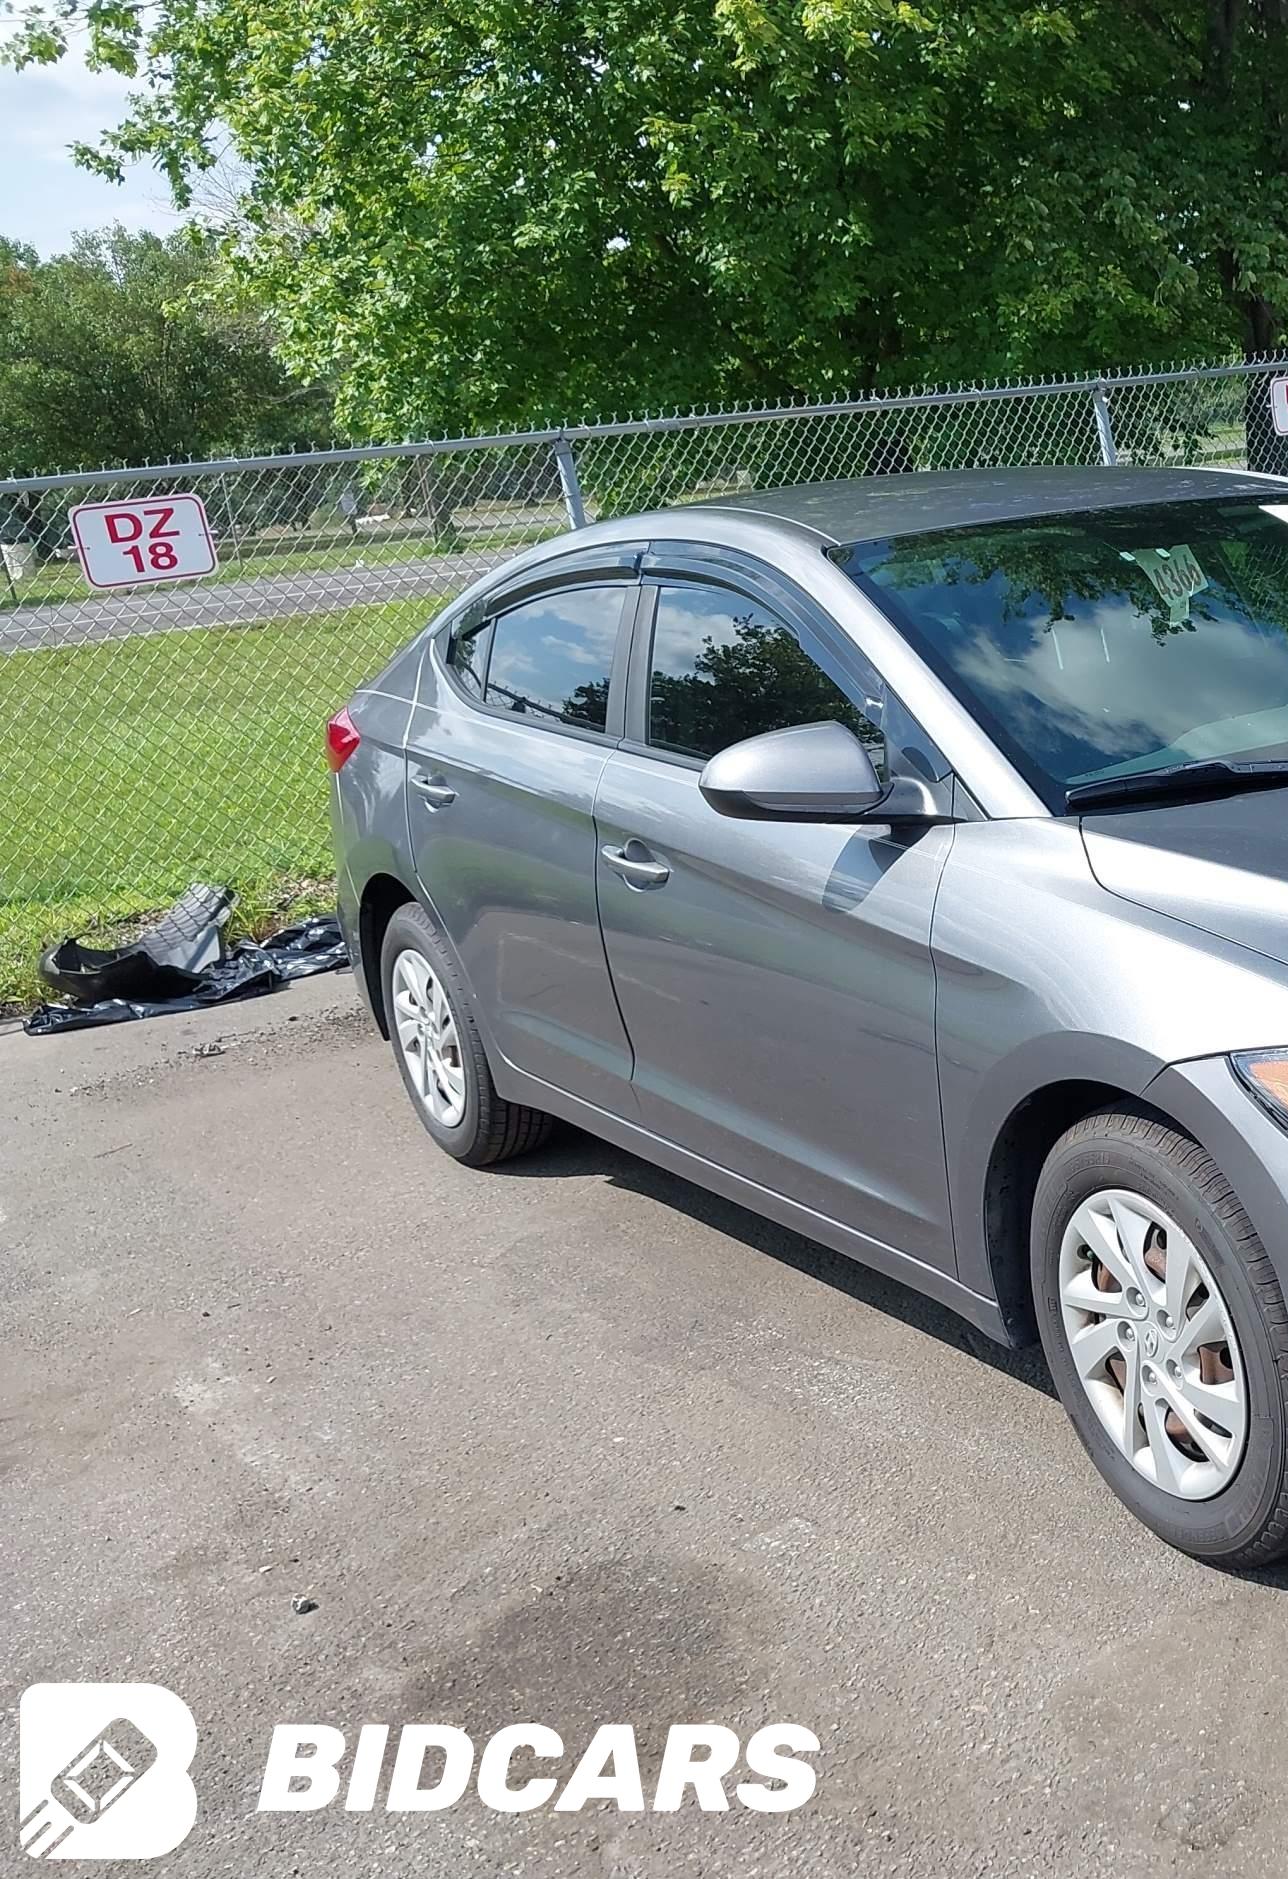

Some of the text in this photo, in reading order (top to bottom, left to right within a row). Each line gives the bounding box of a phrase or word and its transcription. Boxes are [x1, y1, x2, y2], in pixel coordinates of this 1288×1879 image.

[104, 508, 180, 543] DZ
[122, 542, 178, 573] 18
[1153, 554, 1201, 601] 4366
